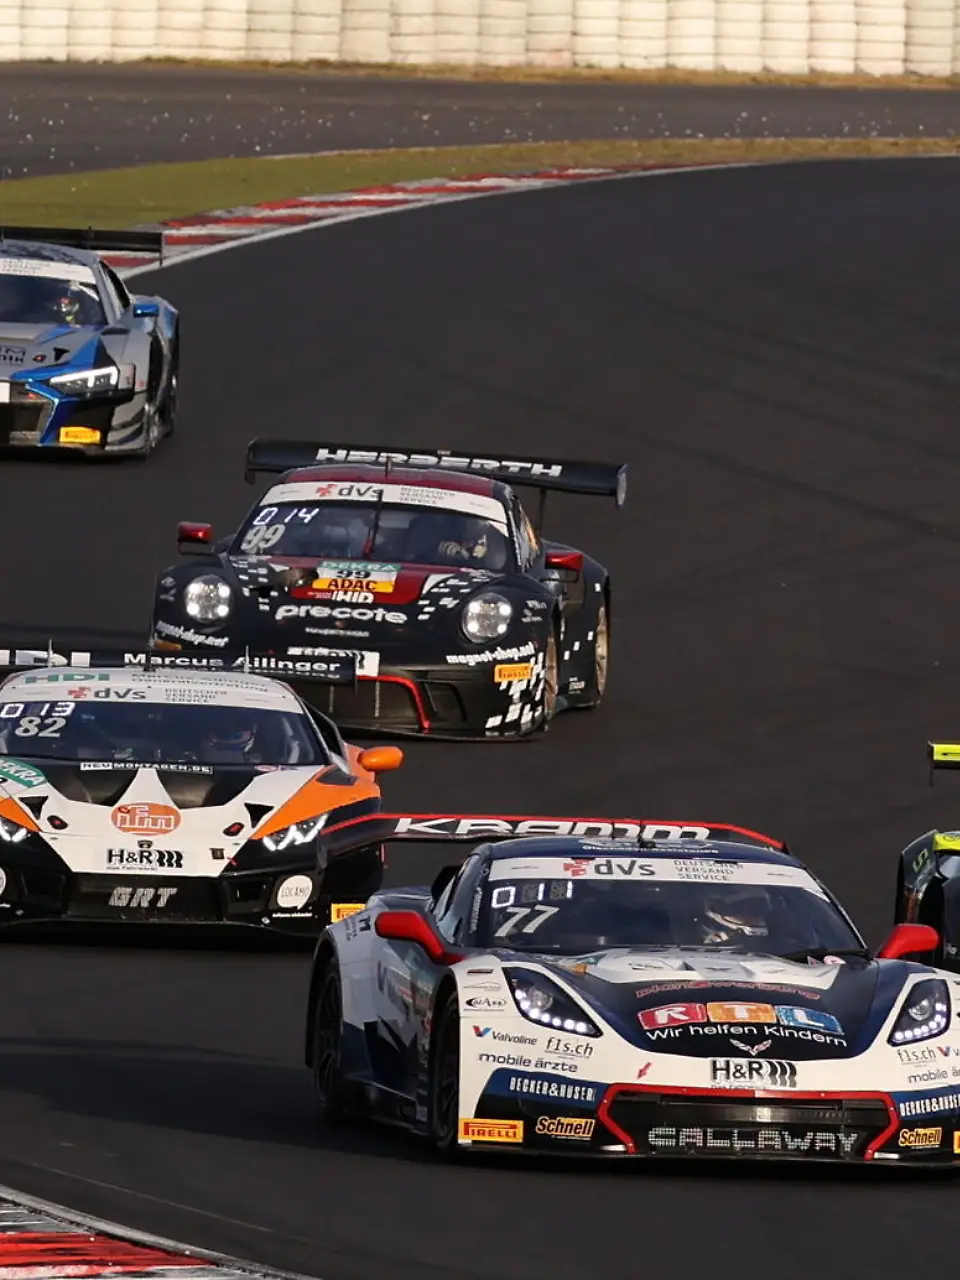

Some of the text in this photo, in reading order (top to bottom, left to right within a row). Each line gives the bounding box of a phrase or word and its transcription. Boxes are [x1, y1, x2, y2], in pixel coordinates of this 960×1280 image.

[337, 483, 383, 499] dvs
[240, 524, 286, 553] 99
[328, 578, 378, 592] ADAC
[275, 605, 407, 624] precote
[124, 652, 224, 667] Marcus
[94, 687, 147, 700] dvs
[15, 716, 67, 738] 82
[118, 804, 174, 830] ifm
[106, 848, 154, 865] H&R
[594, 859, 656, 876] dvs
[108, 886, 178, 908] GRT
[494, 904, 561, 937] 77
[655, 1004, 825, 1028] RTL
[492, 1031, 538, 1046] Valvoline
[647, 1023, 848, 1048] Wir helfen Kindern
[478, 1053, 579, 1073] mobile ärzte
[711, 1059, 764, 1081] H&R
[908, 1069, 948, 1084] mobile
[463, 1121, 519, 1139] PIRELLI
[535, 1116, 594, 1137] Schnell
[648, 1127, 858, 1152] CALLAWAY
[899, 1127, 942, 1146] Schnell
